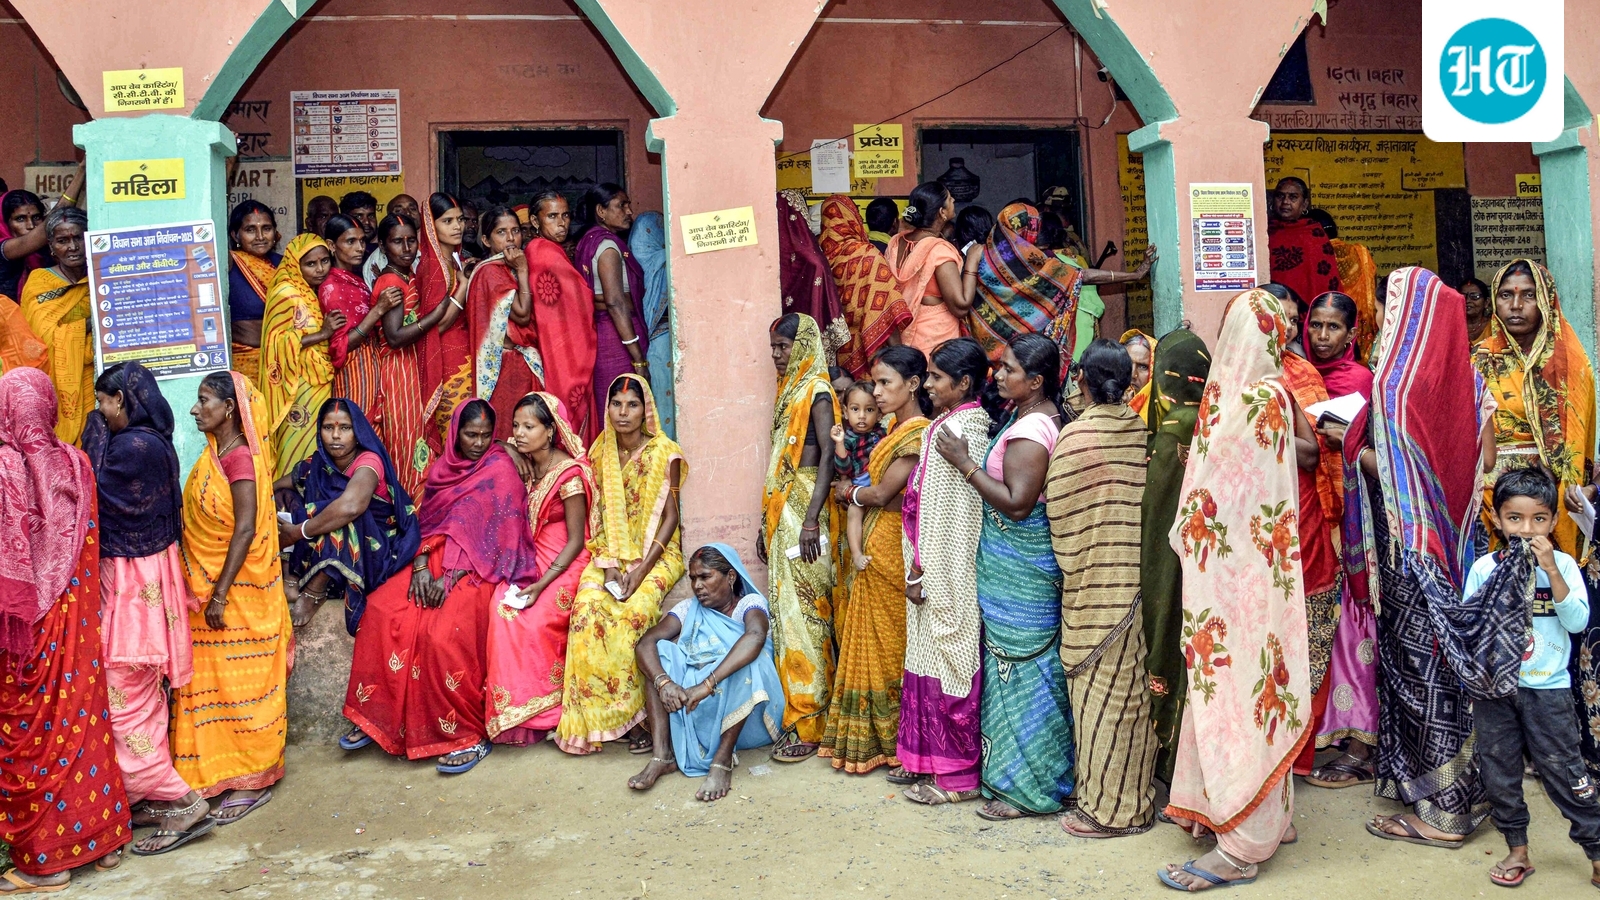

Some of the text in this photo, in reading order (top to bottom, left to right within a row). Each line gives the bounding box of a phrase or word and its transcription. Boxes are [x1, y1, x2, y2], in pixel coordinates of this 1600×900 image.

[118, 98, 150, 106] निगरानी
[859, 133, 899, 148] प्रवेश
[230, 169, 276, 187] HART
[111, 174, 178, 196] महिला
[1519, 182, 1542, 194] निका
[719, 220, 750, 229] कास्टिंग/
[112, 235, 130, 249] विधान
[131, 236, 143, 247] सभा
[144, 236, 155, 246] आम
[696, 239, 727, 248] निगरानी
[109, 263, 134, 274] ईवीएम
[136, 261, 151, 270] और
[102, 286, 106, 294] 1
[103, 302, 109, 310] 2
[105, 318, 111, 326] 3
[106, 334, 113, 343] 4
